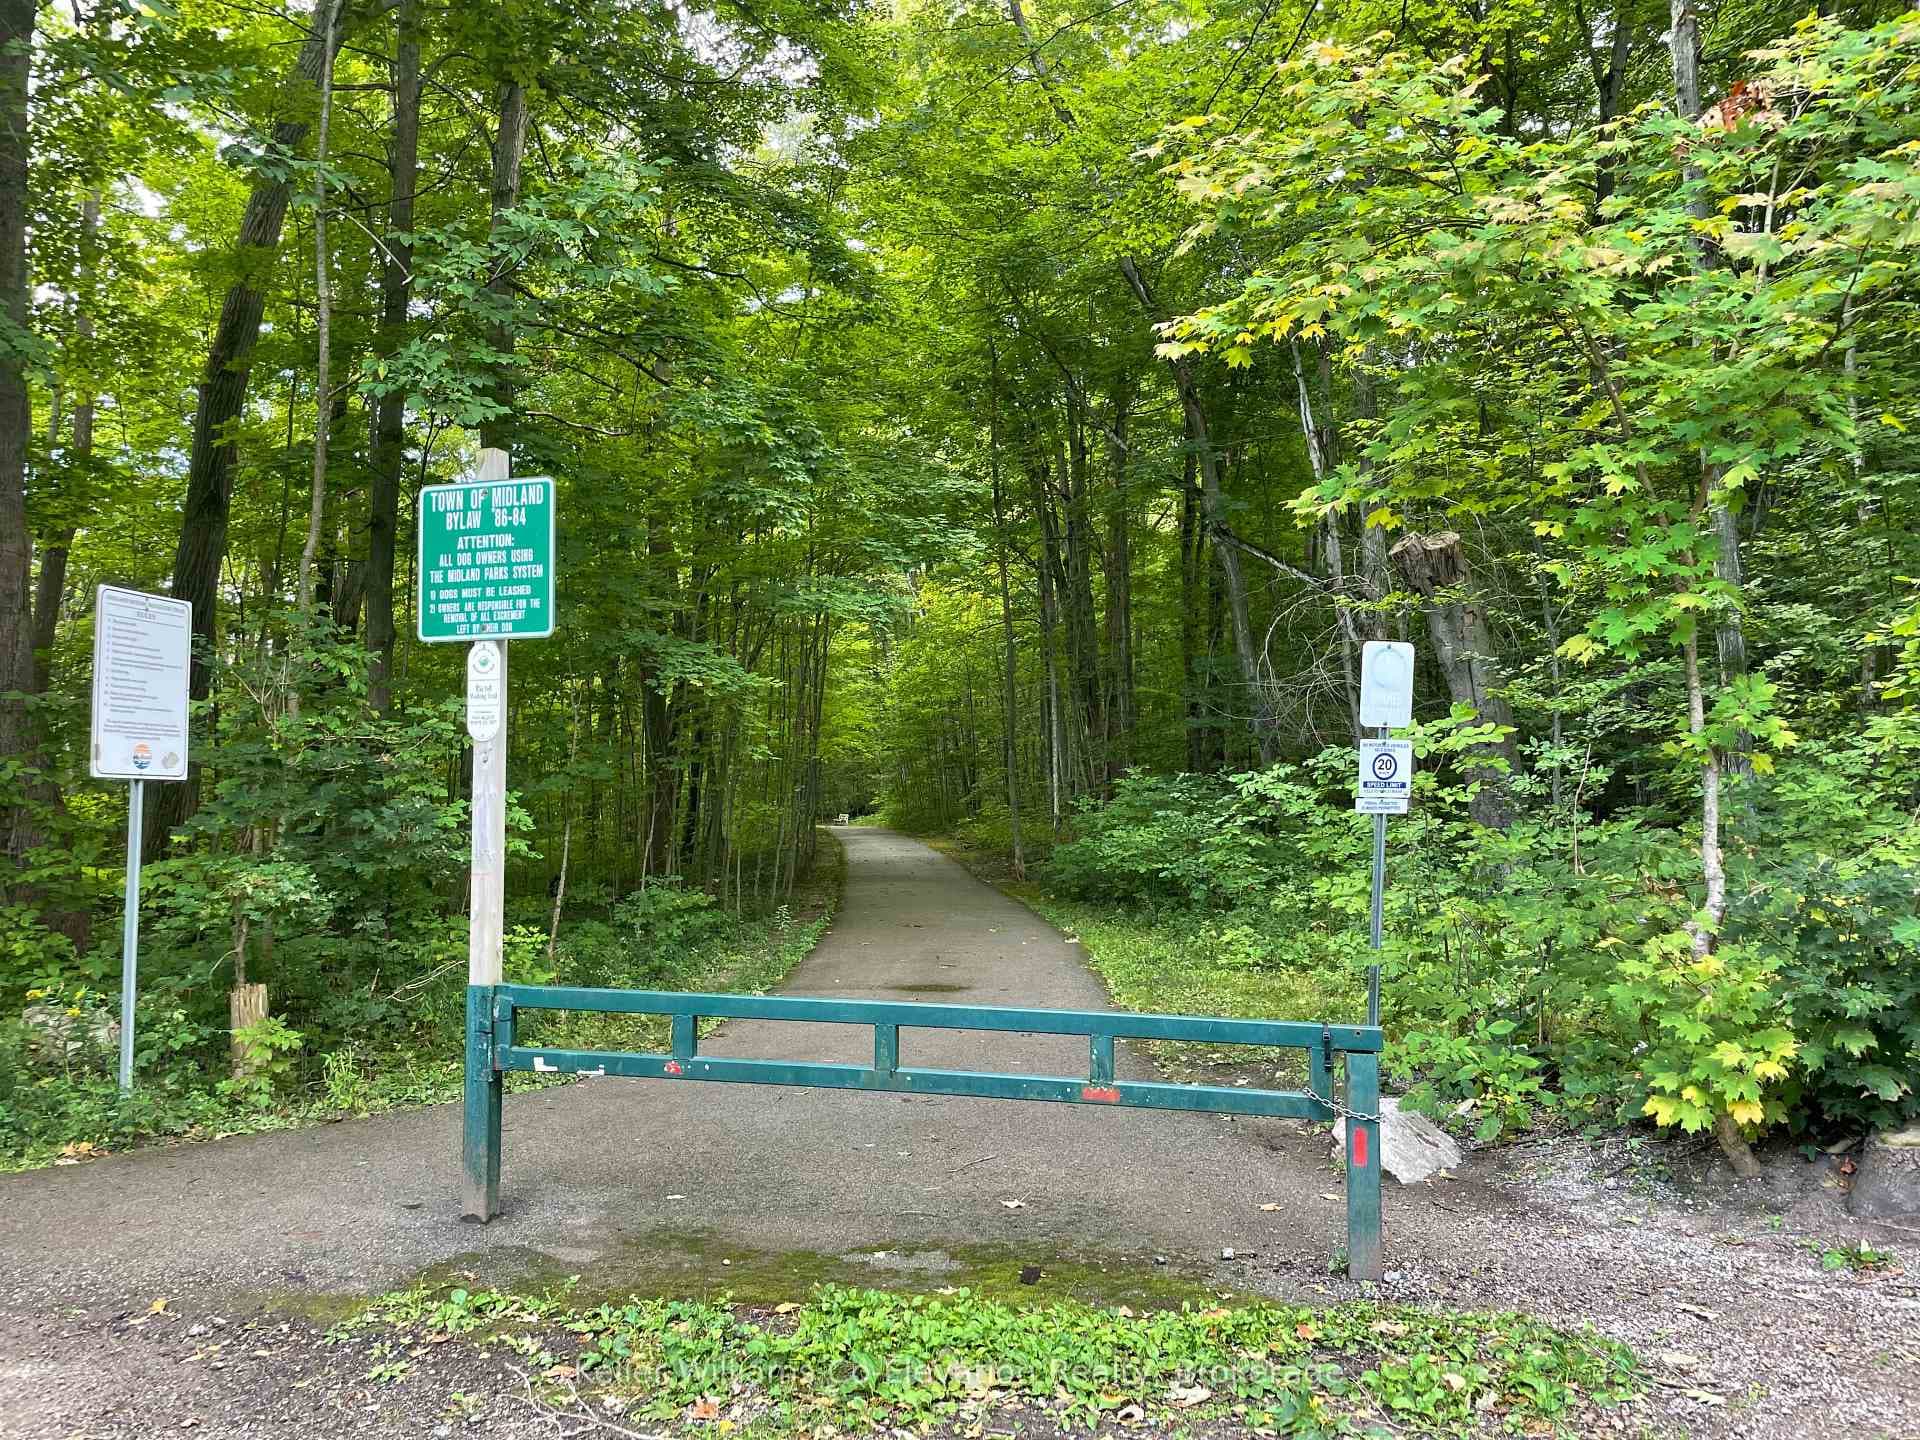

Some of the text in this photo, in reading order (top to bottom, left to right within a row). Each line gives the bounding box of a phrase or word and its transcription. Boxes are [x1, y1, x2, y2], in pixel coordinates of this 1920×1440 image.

[430, 484, 544, 512] TOWN OF MIDLAND
[446, 510, 482, 531] BYLAW
[457, 533, 514, 550] ATTENTION:
[439, 548, 534, 567] ALL DOG OWNERS USING
[430, 564, 544, 583] THE MIDLAND PARKS SYSTEM
[439, 589, 458, 600] DOGS
[461, 587, 482, 598] MUST
[486, 586, 496, 597] BE
[499, 585, 532, 597] LEASHED
[438, 602, 460, 613] OWNERS
[464, 601, 475, 611] ARE
[477, 599, 514, 611] RESPONSIBLE
[516, 598, 527, 609] FOR
[530, 598, 541, 608] THE
[443, 609, 525, 623] REMOVAL OF ALL EXCREMENT
[456, 624, 470, 634] LEFT
[473, 623, 480, 633] BY
[481, 623, 498, 633] HEIR
[1377, 758, 1392, 771] 20
